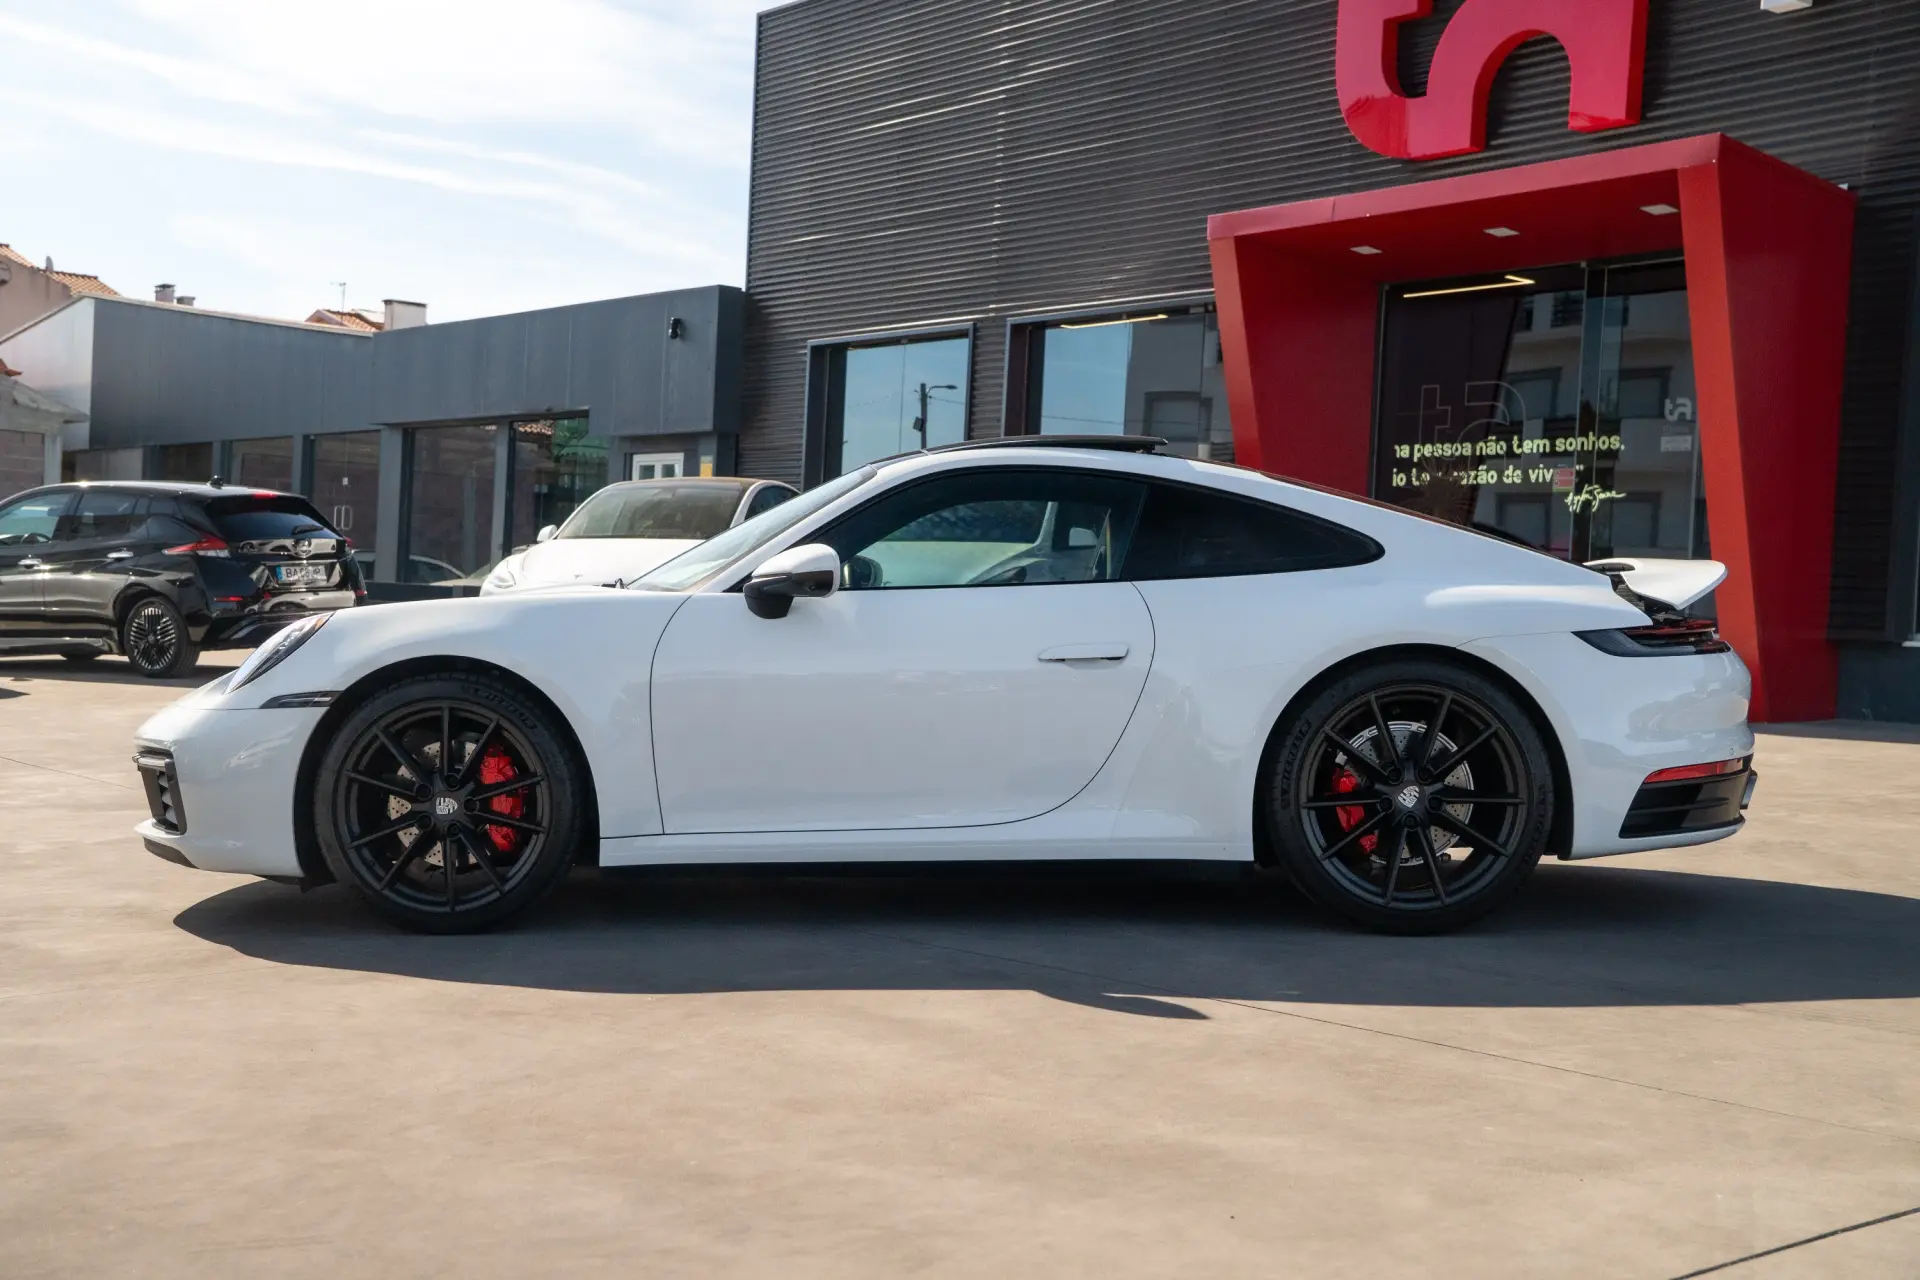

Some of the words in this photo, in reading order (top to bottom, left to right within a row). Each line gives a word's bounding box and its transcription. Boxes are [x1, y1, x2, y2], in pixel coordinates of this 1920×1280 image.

[1413, 441, 1472, 463] pessoa
[1476, 435, 1507, 456] não
[1512, 435, 1550, 454] tem
[1502, 464, 1522, 484] de
